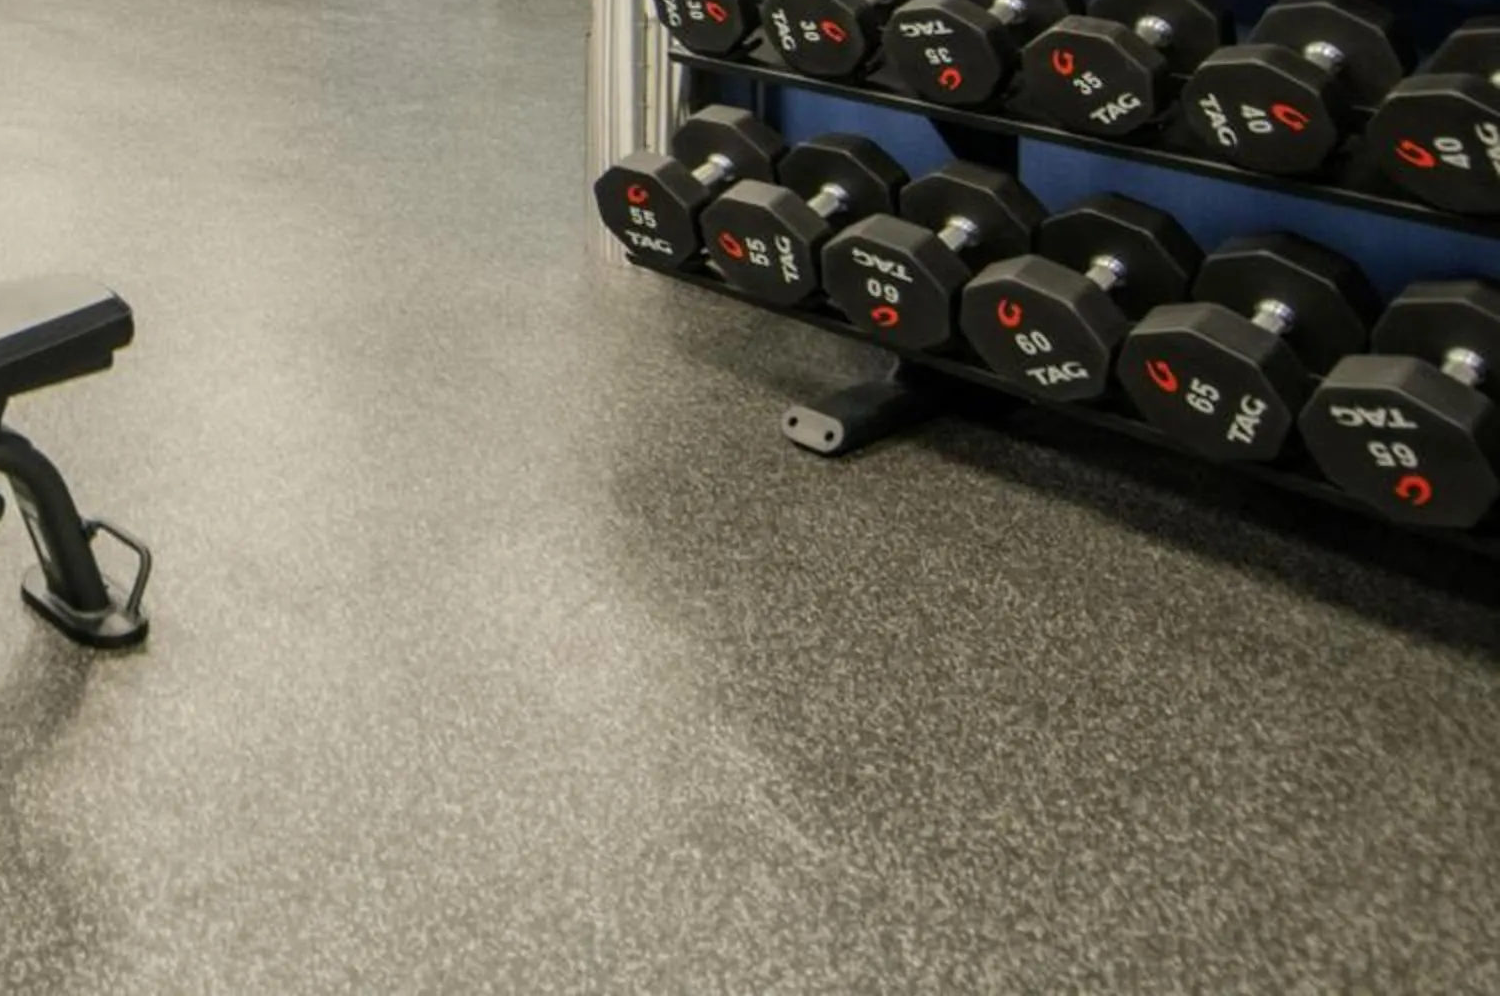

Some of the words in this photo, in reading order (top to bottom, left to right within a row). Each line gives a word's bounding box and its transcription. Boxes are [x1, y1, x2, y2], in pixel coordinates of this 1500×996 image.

[686, 0, 705, 21] 30
[771, 9, 797, 51] TAG
[799, 20, 821, 42] 30
[899, 19, 954, 38] TAG
[924, 47, 953, 66] 35
[1073, 71, 1103, 95] 35
[1090, 92, 1141, 125] TAG
[1199, 93, 1238, 147] TAG
[1241, 104, 1273, 134] 40
[1433, 136, 1470, 169] 40
[629, 206, 657, 229] 55
[626, 230, 674, 255] TAG
[745, 237, 771, 267] 55
[774, 235, 800, 284] TAG
[851, 247, 914, 283] TAG
[866, 277, 901, 304] 60
[1014, 330, 1053, 356] 60
[1026, 360, 1090, 386] TAG
[1186, 377, 1220, 415] 65
[1227, 394, 1267, 445] TAG
[1330, 406, 1418, 430] TAG
[1367, 440, 1419, 468] 65
